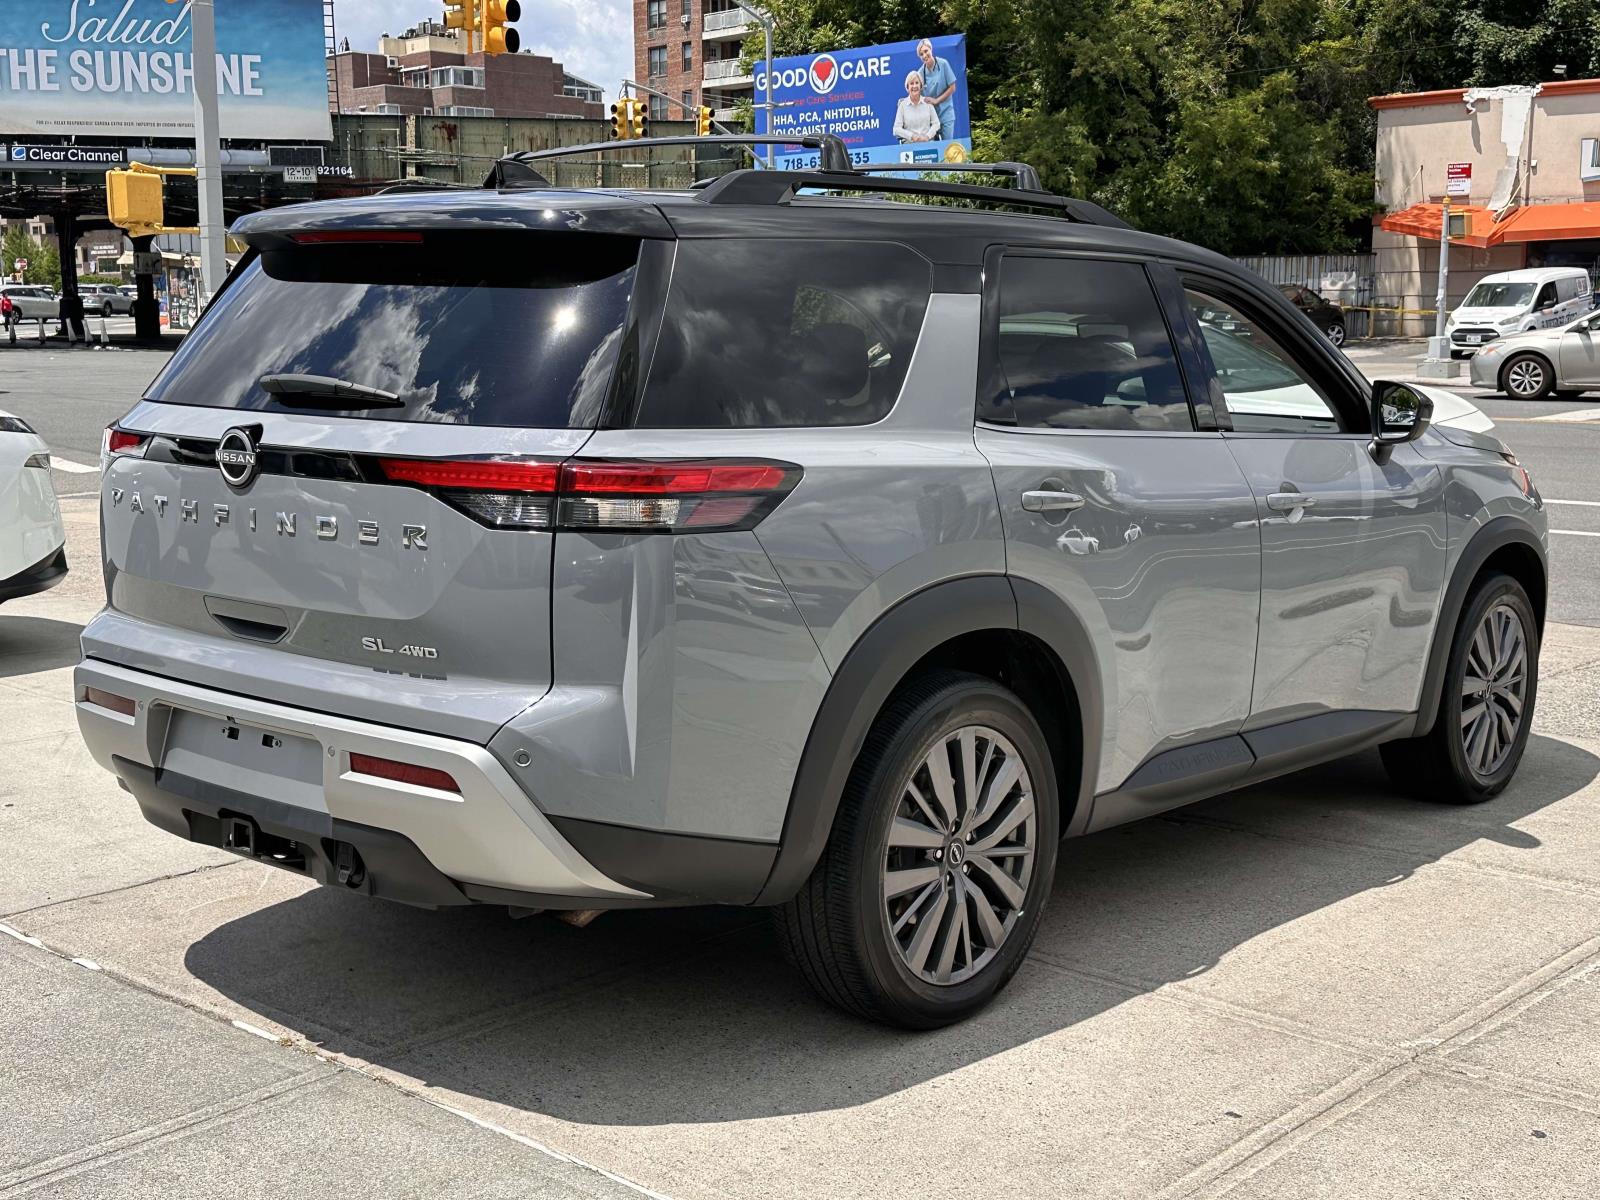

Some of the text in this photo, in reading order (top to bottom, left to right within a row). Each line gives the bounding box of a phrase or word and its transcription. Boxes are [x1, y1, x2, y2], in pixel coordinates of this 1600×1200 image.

[41, 0, 192, 44] Salud
[69, 49, 263, 96] SUNSHNE
[756, 56, 891, 91] GOOD CARE
[773, 105, 874, 126] HHA, PCA, NHTD/TBI,
[829, 118, 880, 134] PROGRAM
[29, 148, 123, 162] Clear Channel
[317, 166, 353, 175] 921164
[215, 450, 255, 465] NISSAN
[111, 487, 428, 550] PATHFINDER
[361, 636, 438, 659] SL 4WD
